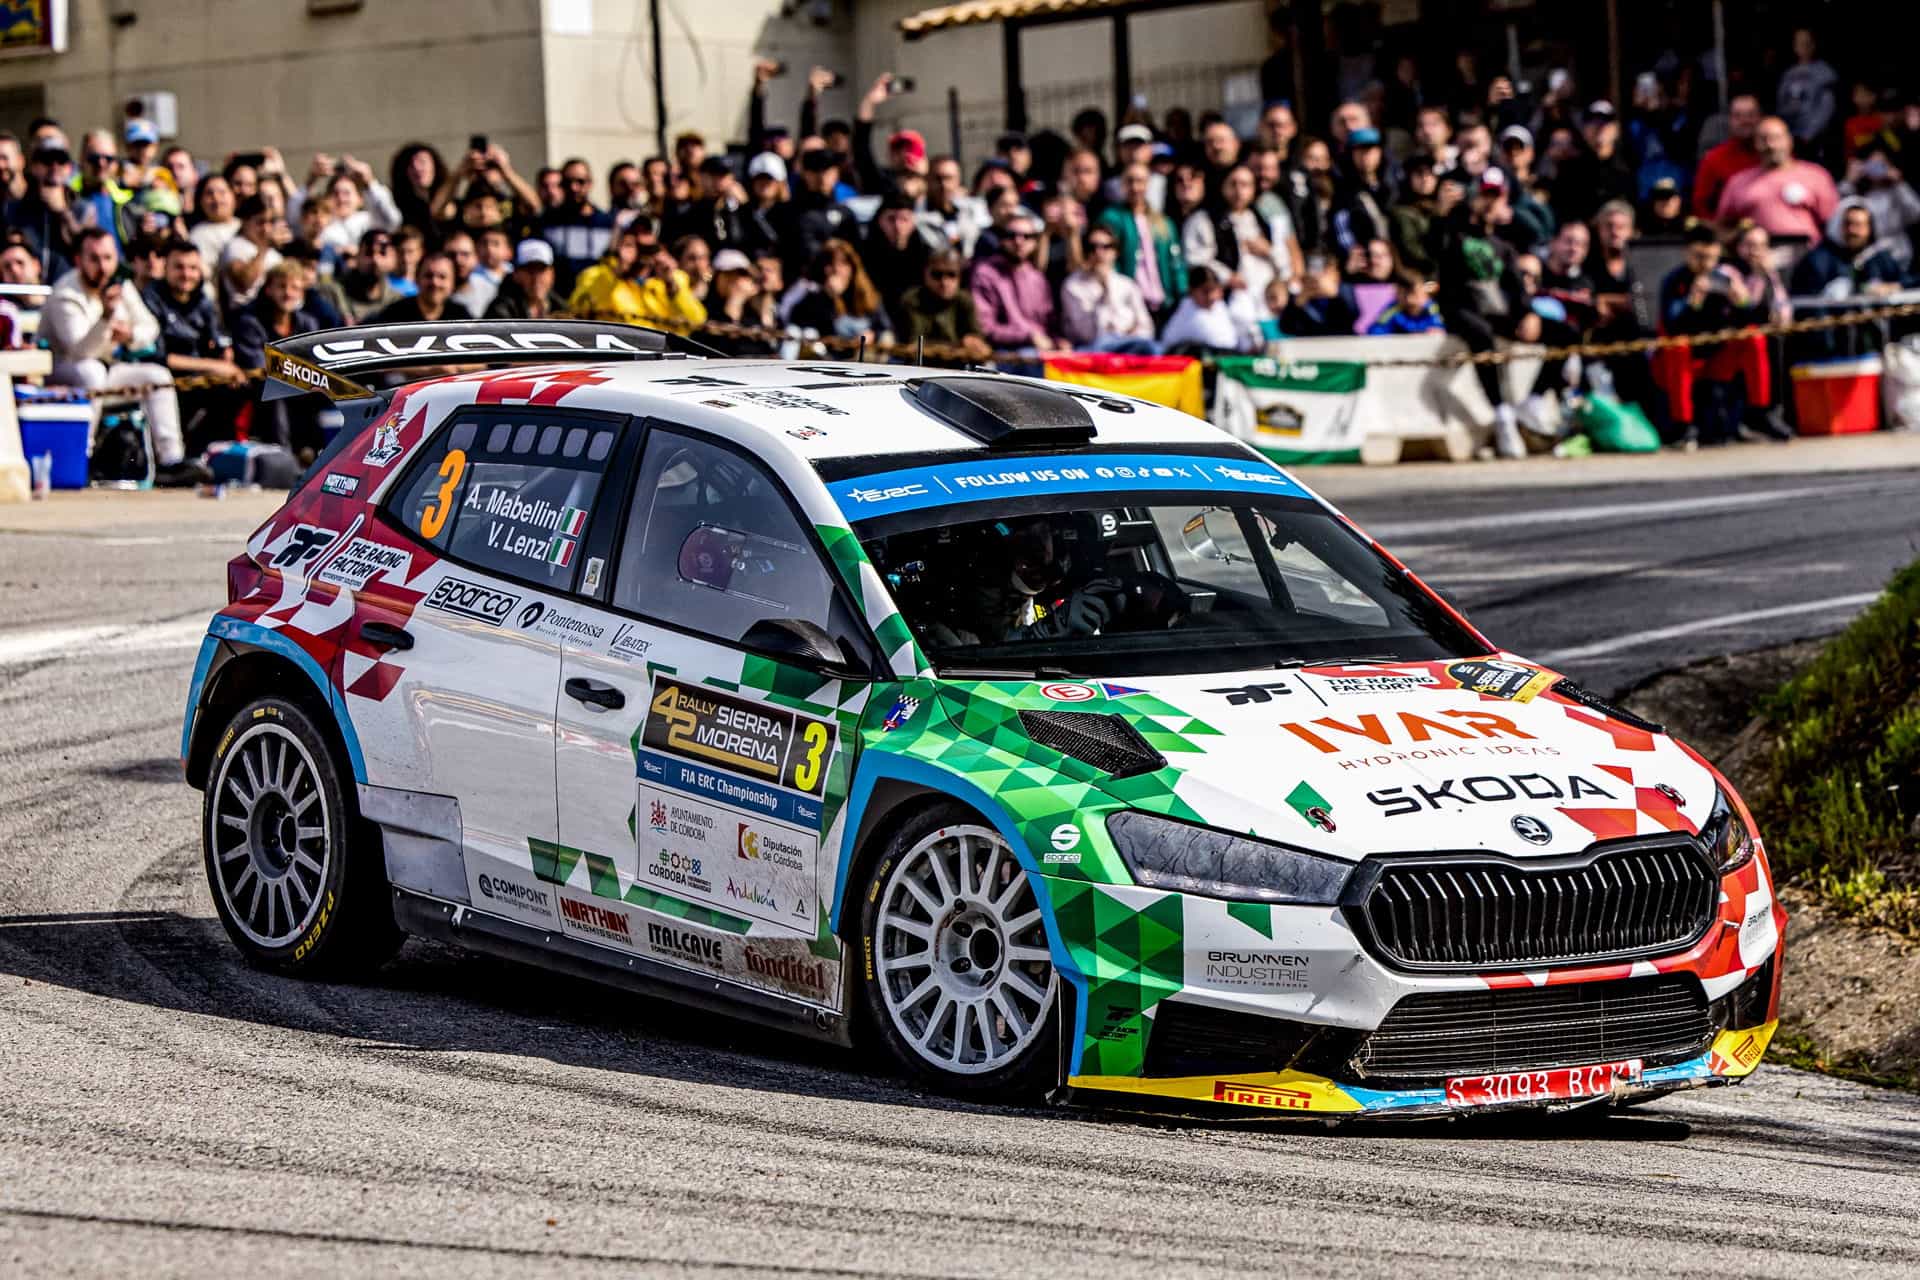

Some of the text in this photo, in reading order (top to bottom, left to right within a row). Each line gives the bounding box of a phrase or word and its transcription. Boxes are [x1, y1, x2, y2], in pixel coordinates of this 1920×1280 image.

[954, 472, 1031, 488] FOLLOW
[1031, 470, 1060, 481] US
[1060, 468, 1090, 480] ON
[420, 449, 467, 539] 3
[464, 484, 565, 531] A. Mabellini
[345, 542, 406, 569] THE RACING
[487, 521, 552, 561] V. Lenzi
[328, 556, 379, 579] FACTORY
[434, 581, 514, 618] sparco
[543, 608, 605, 639] Pontenossa
[1331, 683, 1412, 692] FACTORY
[678, 695, 717, 716] RALLY
[716, 705, 783, 741] SIERRA
[1279, 709, 1539, 753] IVAR
[696, 724, 778, 764] MORENA
[794, 722, 828, 792] 3
[1338, 745, 1561, 770] HYDRONIC IDEAS
[681, 767, 696, 785] FIA
[697, 773, 716, 790] ERC
[717, 779, 778, 811] Championship
[1366, 773, 1617, 818] SKODA
[671, 806, 713, 829] AYUNTAMIENTO
[763, 836, 803, 858] Diputación
[773, 852, 803, 871] Córdoba
[649, 863, 687, 886] CÓRDOBA
[492, 879, 548, 906] COMIPONT
[648, 922, 722, 961] ITALCAVE
[744, 945, 825, 990] fondital
[1207, 964, 1309, 982] INDUSTRIE
[1208, 951, 1309, 966] BRUNNEN
[1213, 1080, 1312, 1109] PIRELLI
[1449, 1078, 1465, 1106] S
[1481, 1071, 1549, 1104] 3093
